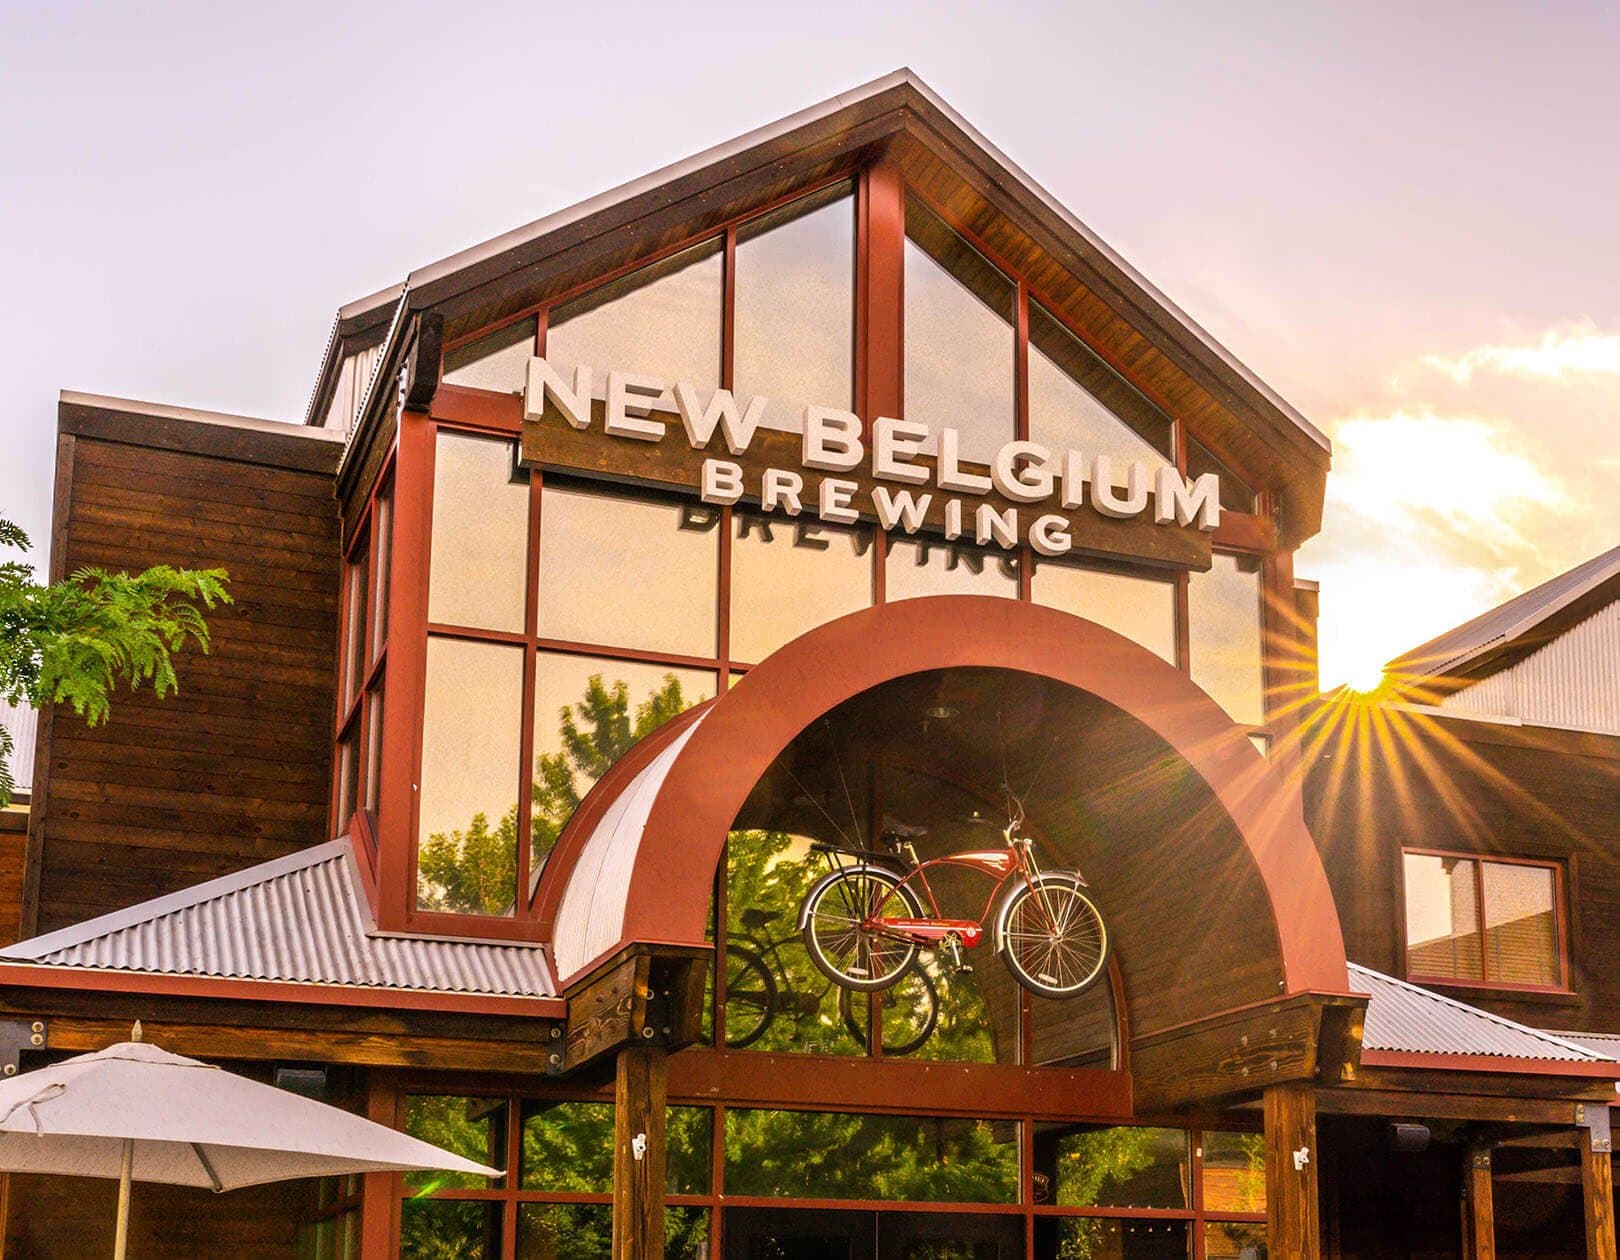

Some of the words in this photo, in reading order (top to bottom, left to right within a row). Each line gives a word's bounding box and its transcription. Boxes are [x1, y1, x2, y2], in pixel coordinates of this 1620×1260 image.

[524, 356, 767, 455] NEW
[802, 405, 1220, 532] BELGIUM
[701, 458, 1072, 556] BREWING
